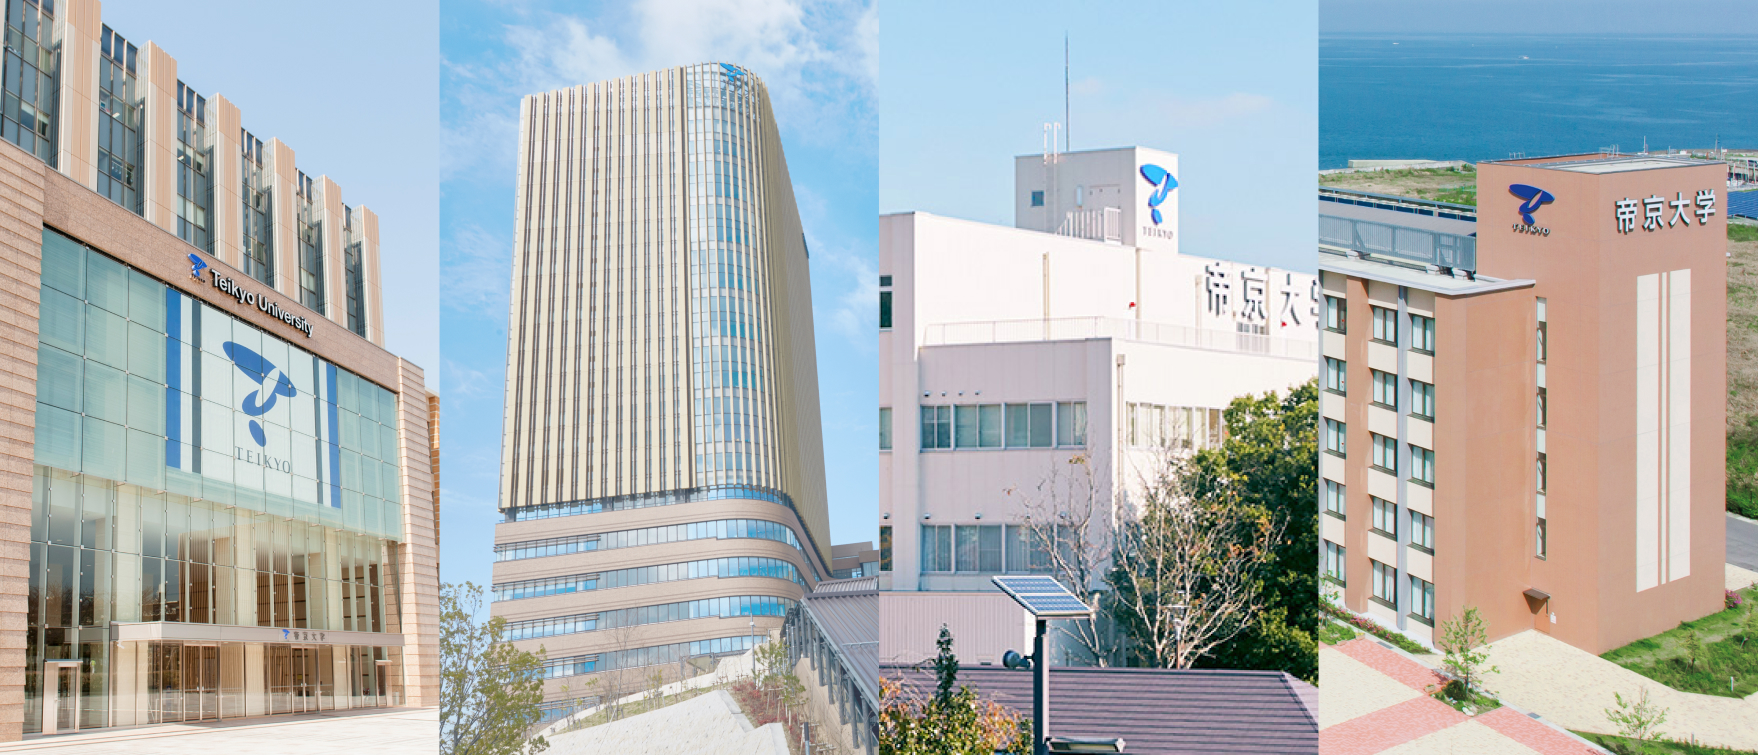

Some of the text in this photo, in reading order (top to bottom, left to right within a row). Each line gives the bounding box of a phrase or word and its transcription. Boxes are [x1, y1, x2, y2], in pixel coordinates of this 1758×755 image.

[1615, 189, 1717, 235] 帝京大学
[1142, 226, 1174, 240] TEIKYO
[1512, 223, 1551, 236] TEIKYO
[210, 268, 314, 338] Teikyo University
[234, 445, 291, 474] TEIKYO
